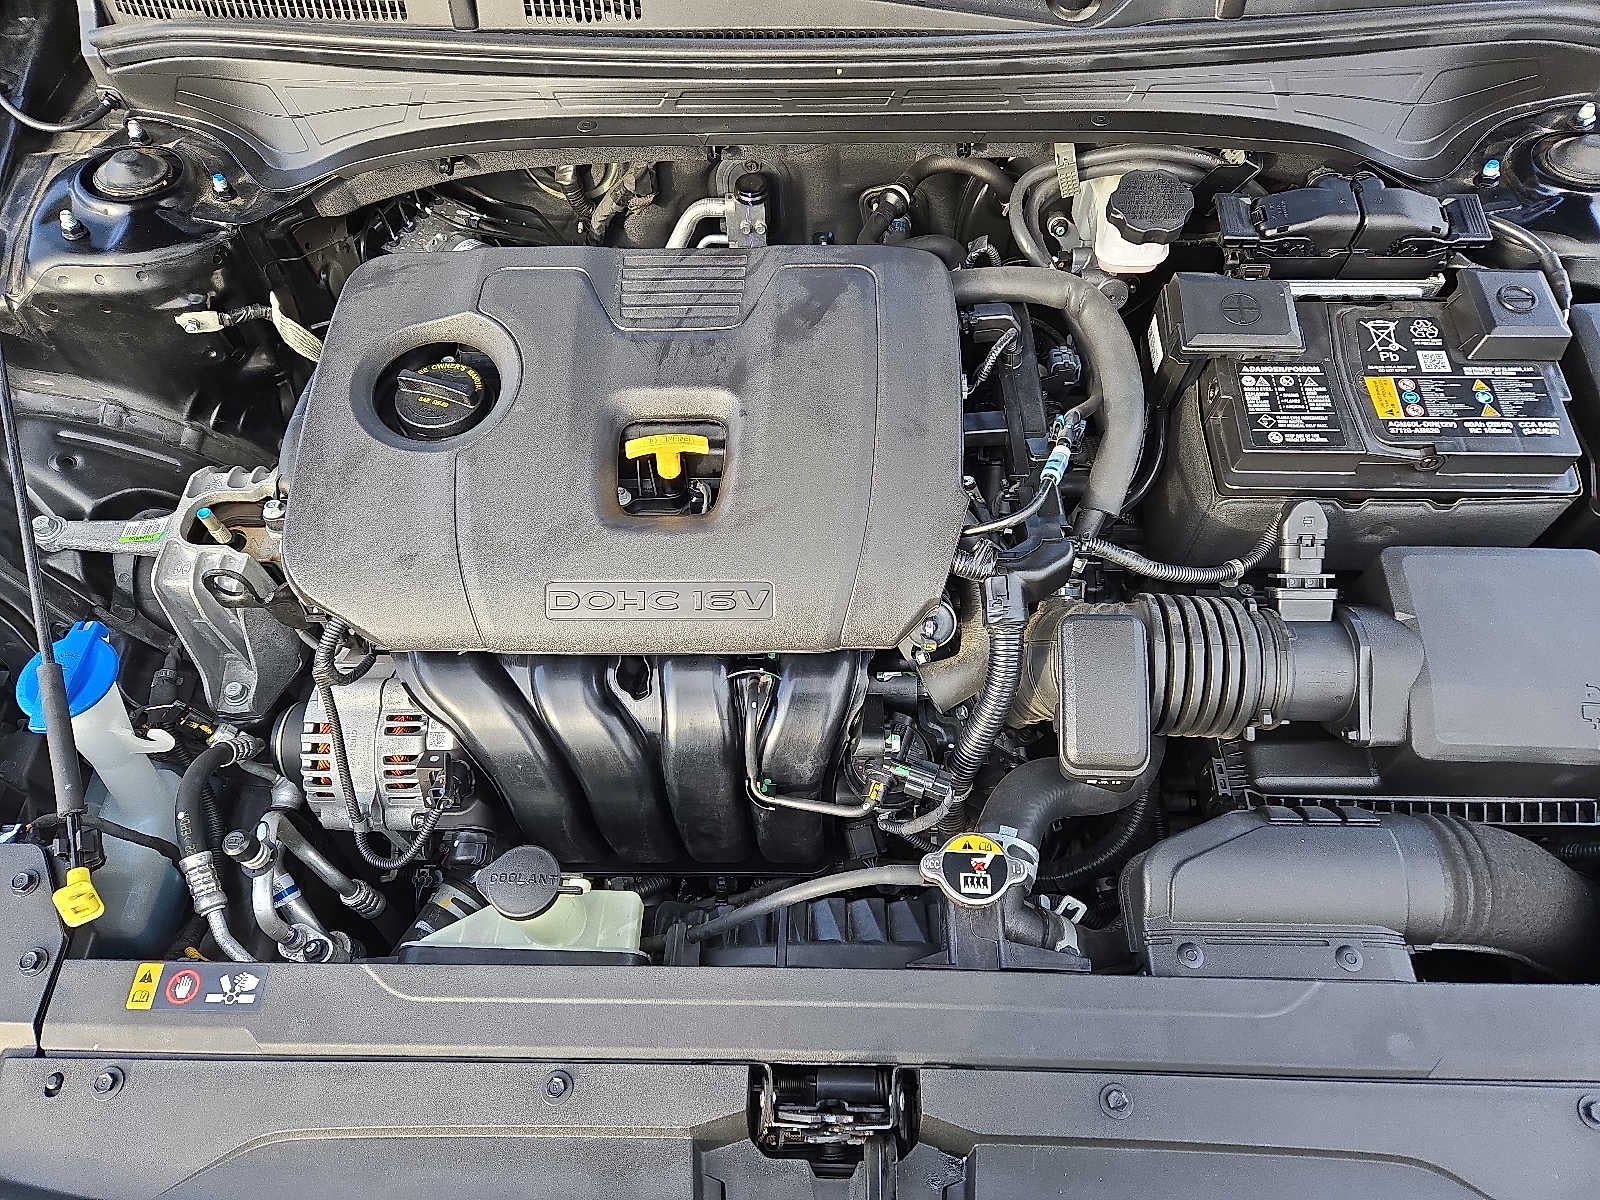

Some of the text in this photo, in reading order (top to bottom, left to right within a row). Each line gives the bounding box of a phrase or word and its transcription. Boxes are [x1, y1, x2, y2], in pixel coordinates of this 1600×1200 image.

[1379, 351, 1400, 362] Pb
[549, 590, 770, 610] DOHC 16V
[490, 872, 559, 886] COOLANT
